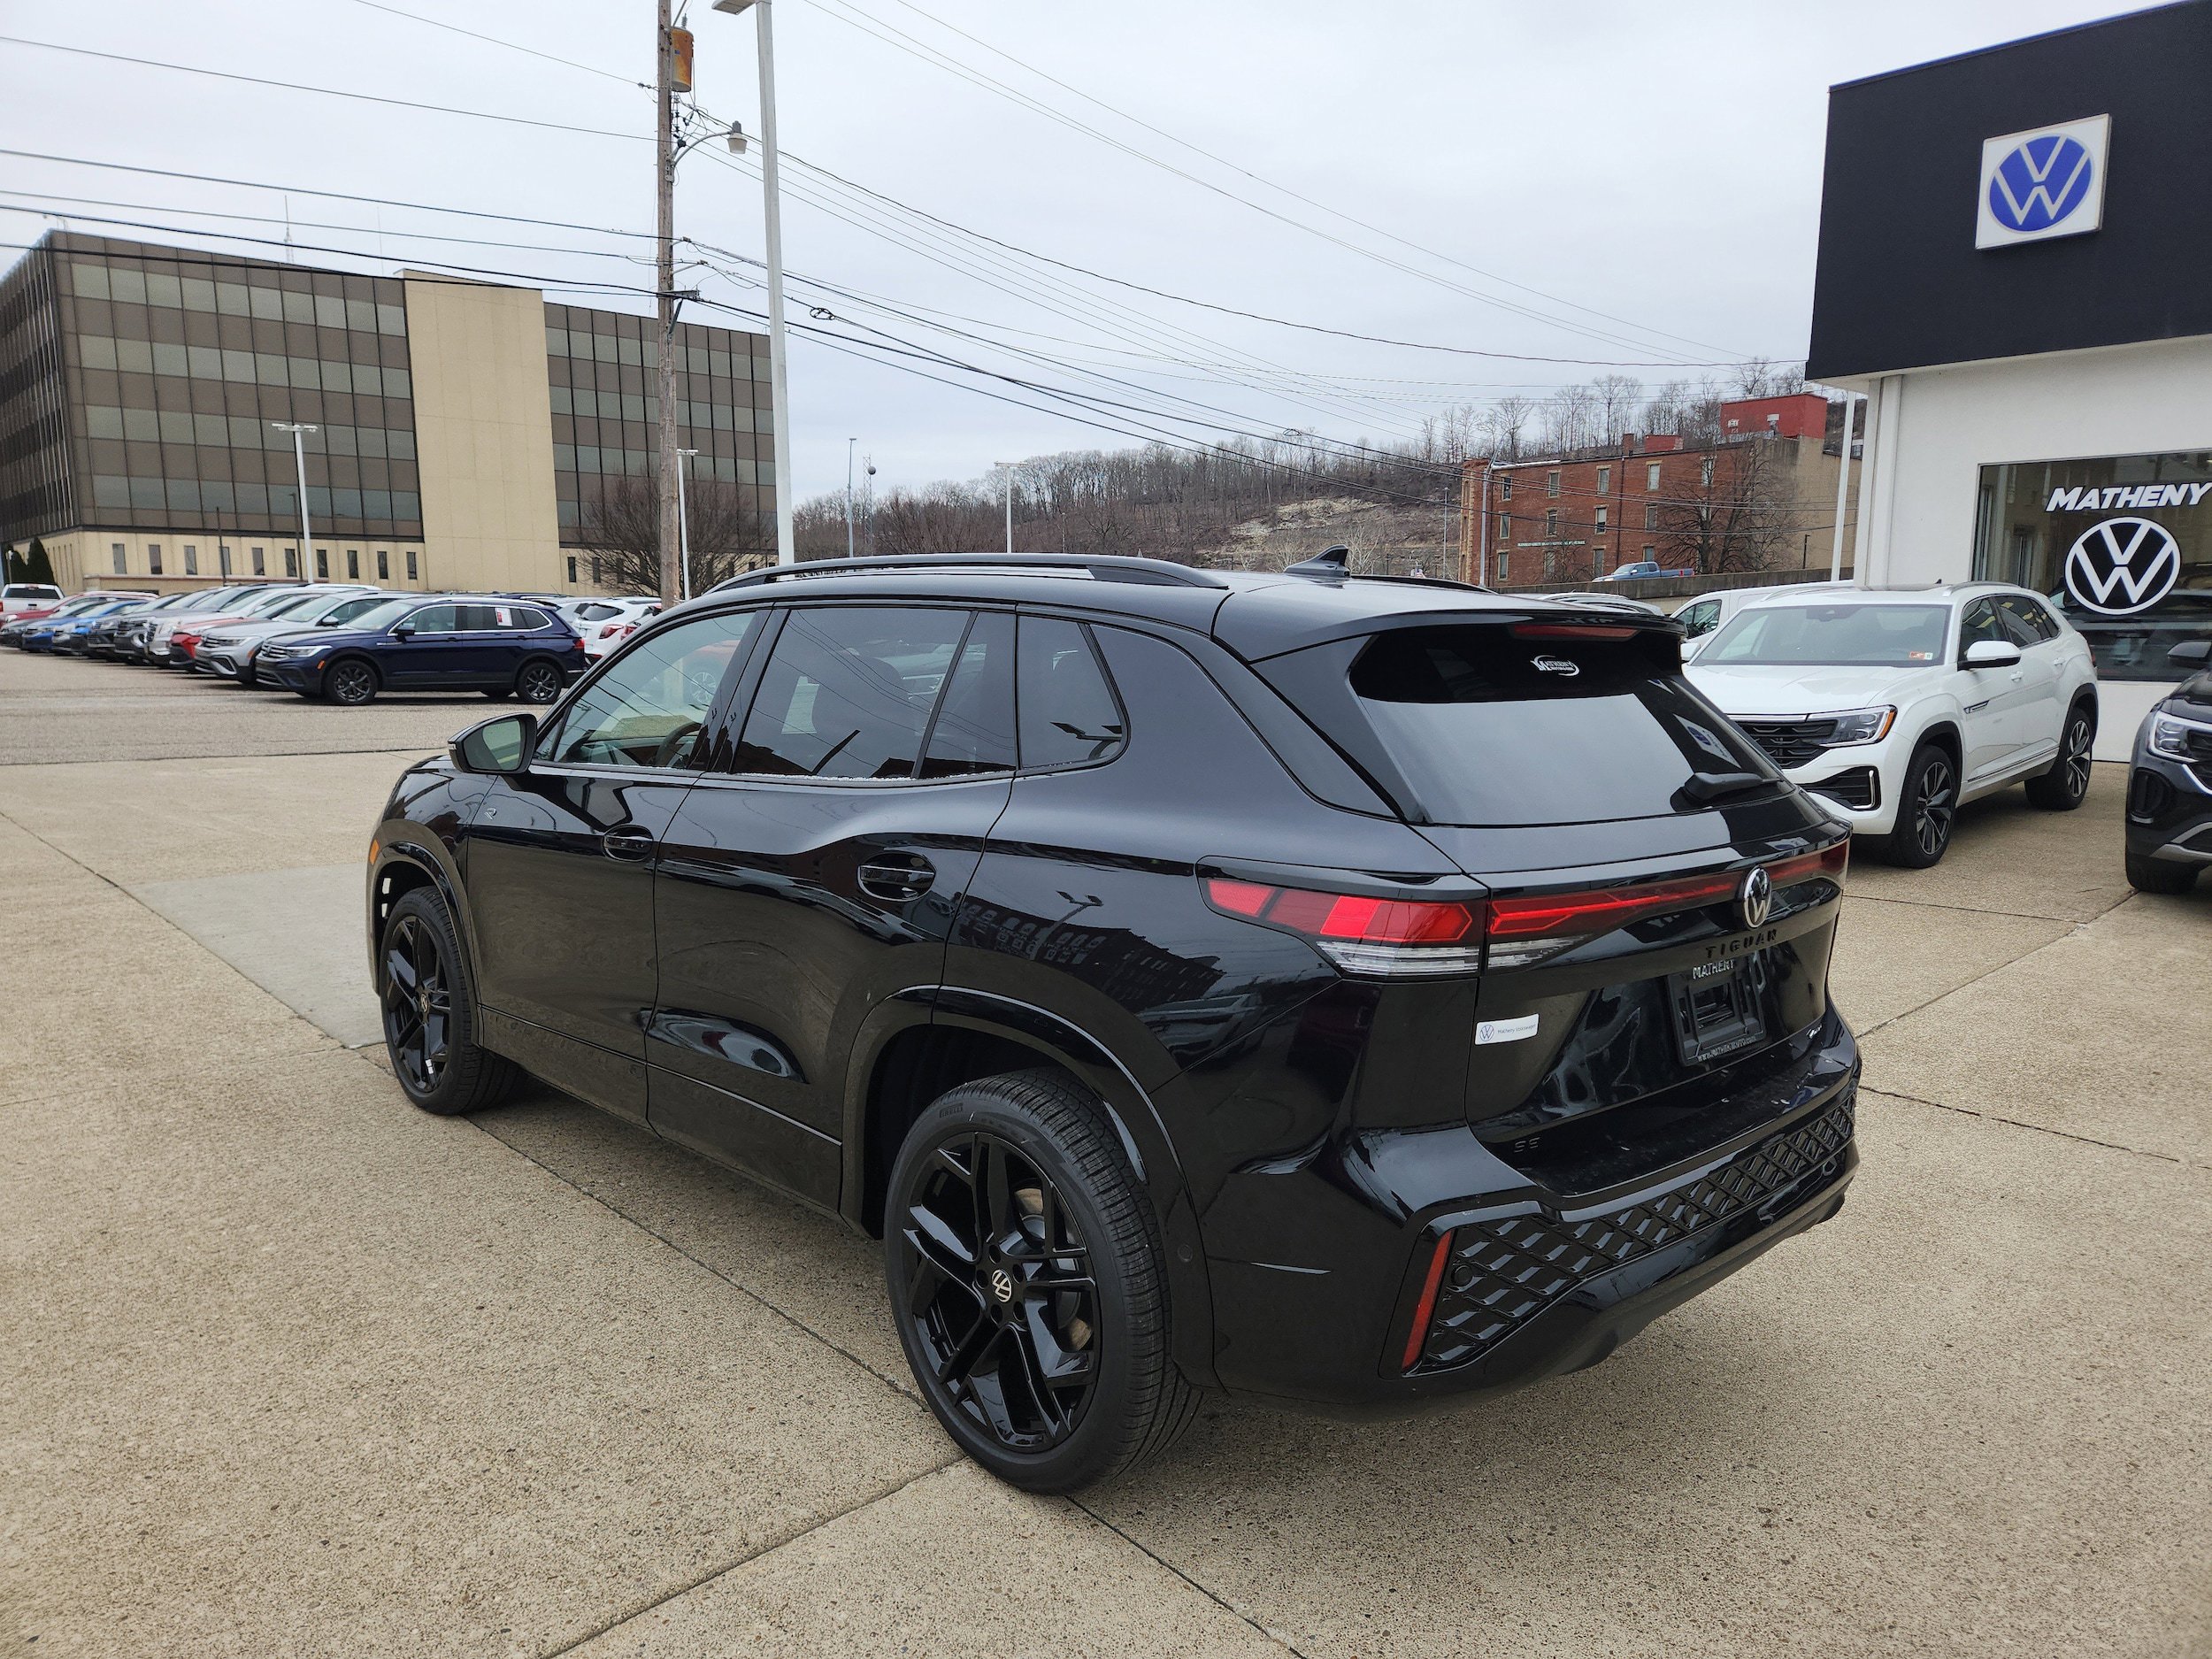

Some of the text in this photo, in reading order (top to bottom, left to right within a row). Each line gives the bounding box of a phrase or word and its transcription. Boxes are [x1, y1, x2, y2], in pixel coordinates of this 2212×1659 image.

[1987, 133, 2094, 234] VW
[2046, 482, 2212, 512] MATHENY
[2065, 517, 2181, 615] VW
[1743, 866, 1772, 929] VW
[1705, 929, 1778, 958] TIGUAN
[1692, 959, 1735, 979] MATHENY
[1479, 1025, 1494, 1041] VW
